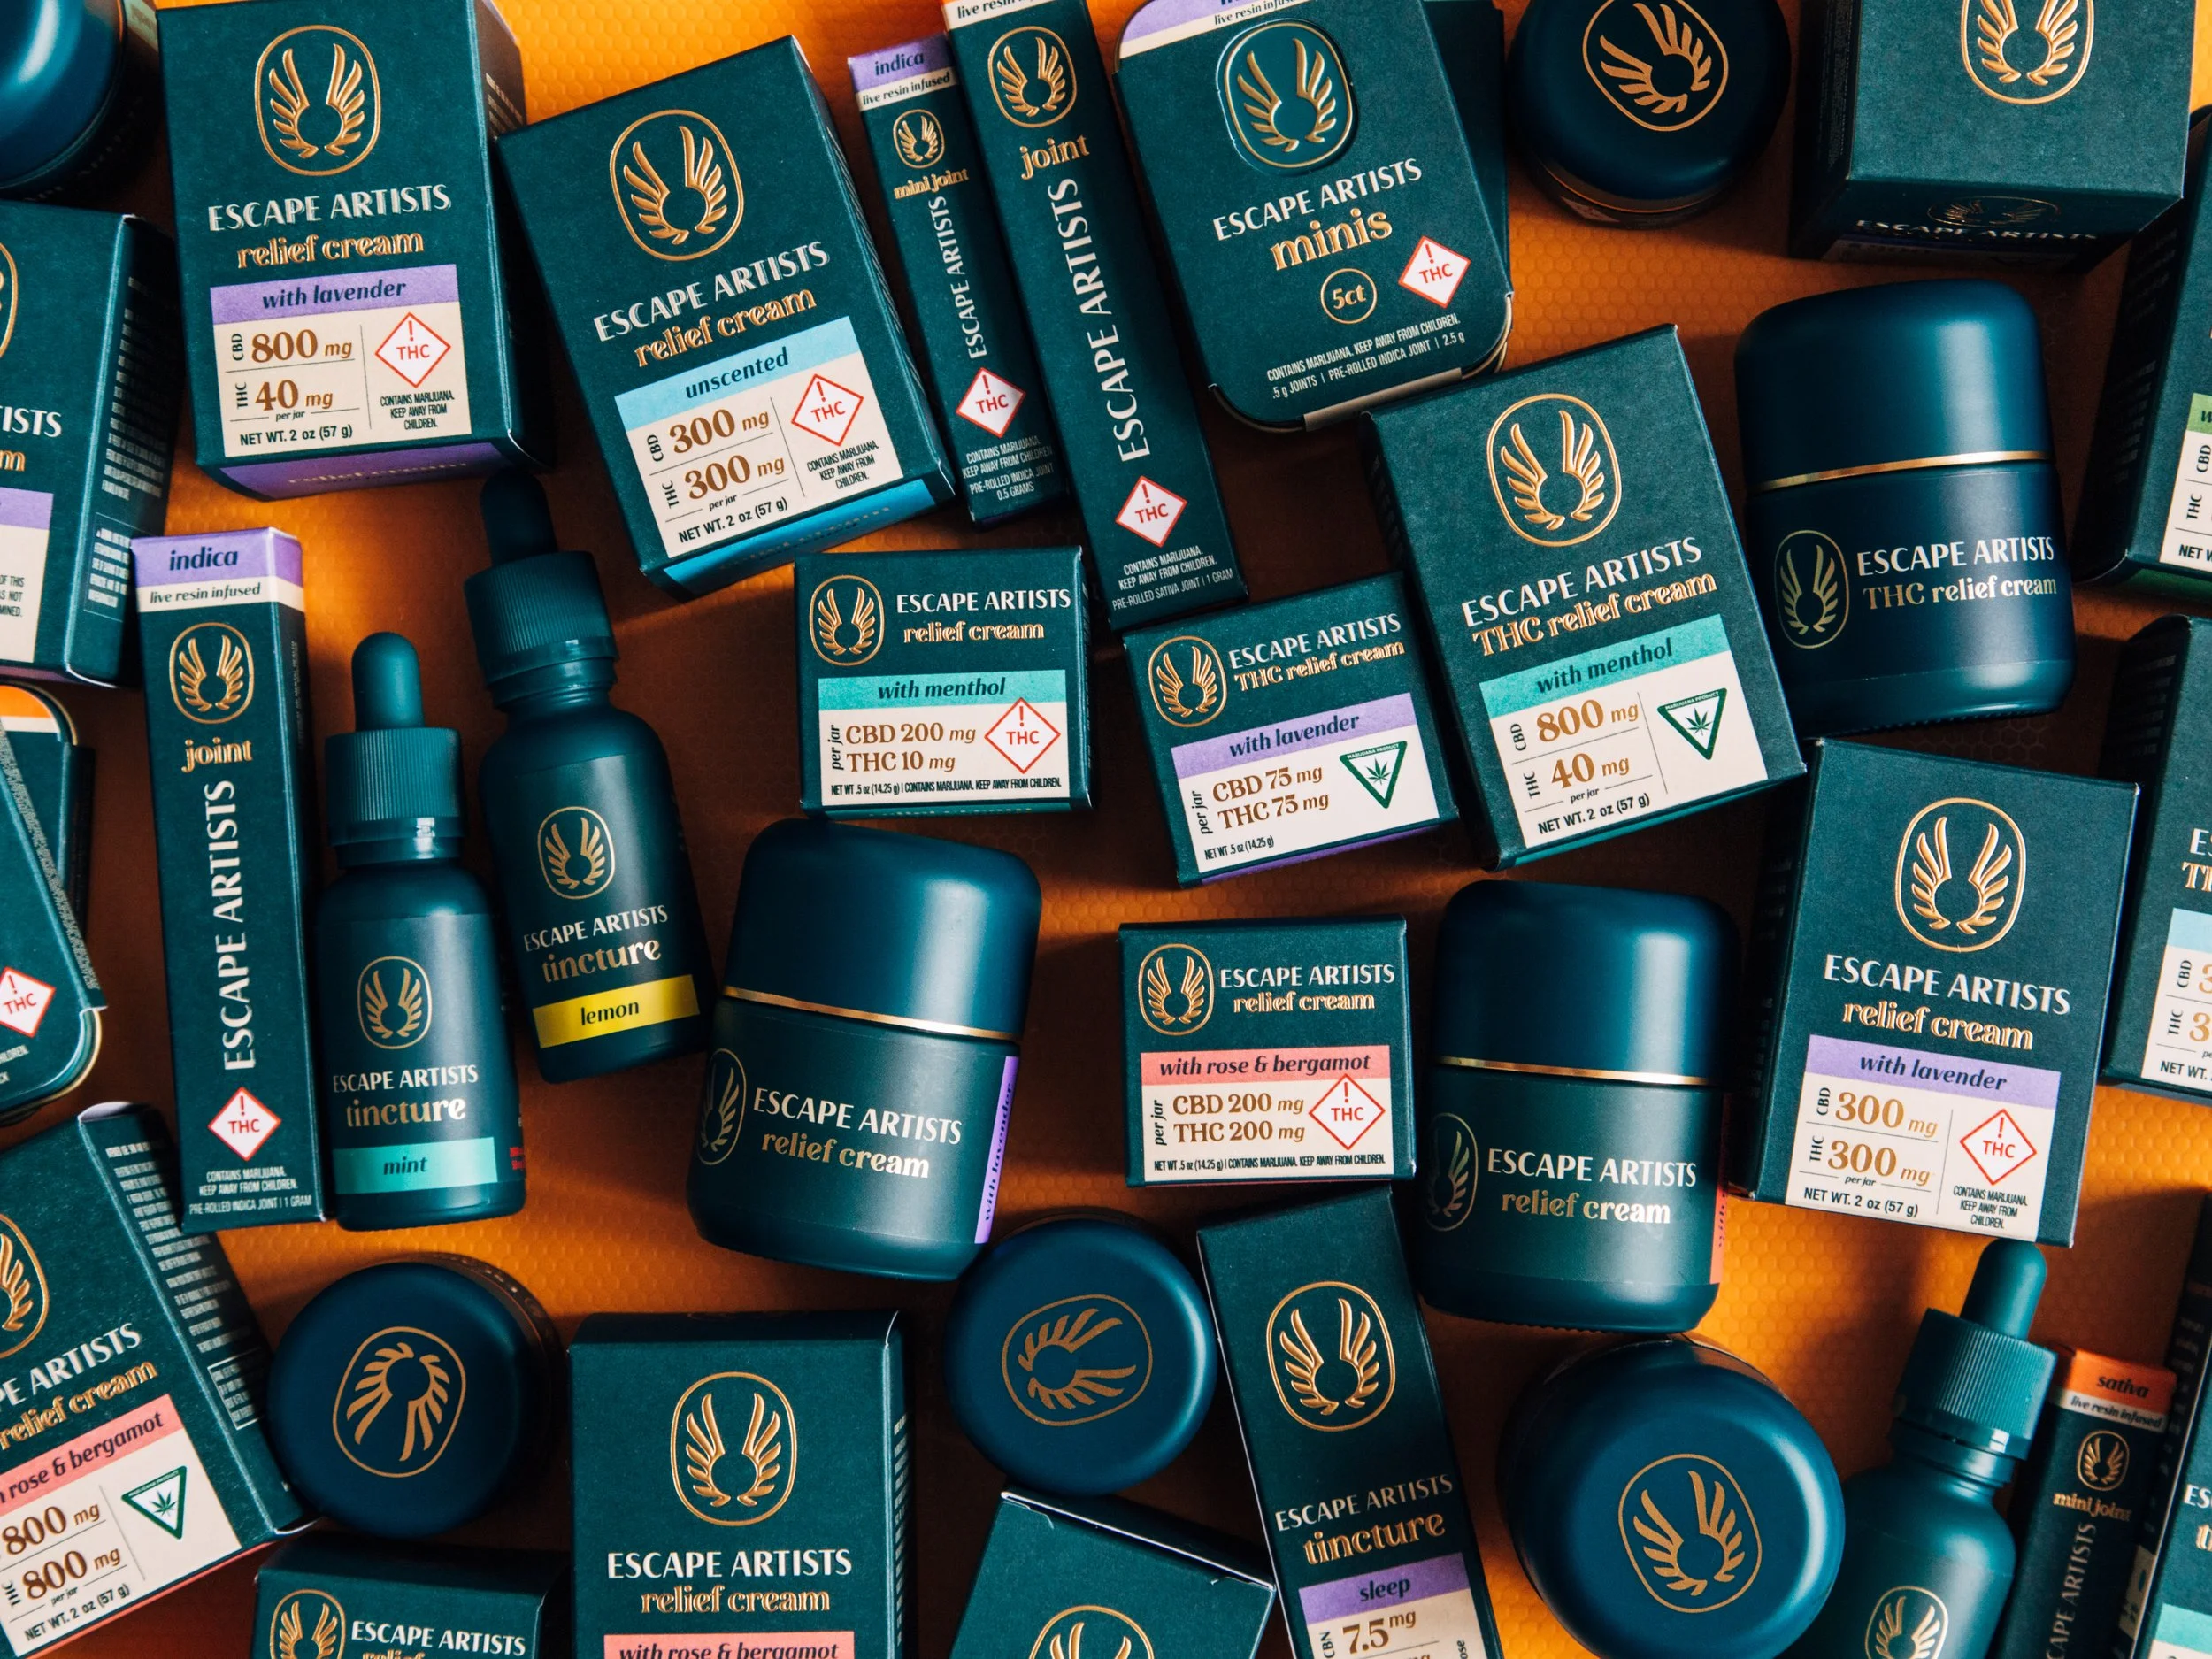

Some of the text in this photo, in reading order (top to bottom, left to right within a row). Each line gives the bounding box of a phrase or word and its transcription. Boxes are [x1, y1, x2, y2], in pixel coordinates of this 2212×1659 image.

[874, 50, 925, 76] indica
[862, 73, 950, 106] live resin infused
[1020, 134, 1090, 180] joint
[894, 168, 970, 200] mini joint
[1212, 158, 1422, 242] ESCAPE ARTISTS
[208, 184, 451, 231] ESCAPE ARTISTS
[237, 233, 424, 268] relief cream
[1270, 207, 1393, 272] minis
[928, 196, 987, 359] ESCAPE ARTISTS
[1419, 264, 1453, 284] THC
[262, 280, 406, 309] with lavender
[593, 242, 830, 342] ESCAPE ARTISTS
[1332, 284, 1366, 309] 5ct
[634, 289, 817, 367] relief cream
[1047, 178, 1151, 462] ESCAPE ARTISTS
[251, 330, 352, 363] 800 mg
[396, 344, 429, 360] THC
[1266, 313, 1460, 381] CONTAINS MARIJUANA. KEEP AWAY FROM CHILDREN.
[686, 346, 789, 399] unscented
[811, 402, 846, 424] THC
[976, 395, 1009, 414] THC
[240, 425, 353, 445] NET WT. 2 oz (57 g)
[669, 409, 770, 454] 300 mg
[1135, 503, 1169, 524] THC
[169, 546, 239, 572] indica
[1118, 555, 1217, 591] KEEP AWAY FROM CHILDREN.
[1124, 545, 1202, 575] CONTAINS MARIJUANA.
[1857, 536, 2054, 576] ESCAPE ARTISTS
[150, 582, 261, 603] live resin infused
[1461, 537, 1702, 628] ESCAPE ARTISTS
[1863, 575, 2056, 610] THC relief cream
[896, 589, 1071, 613] ESCAPE ARTISTS
[1472, 573, 1717, 657] THC relief cream
[903, 620, 1044, 643] relief cream
[1228, 613, 1402, 670] ESCAPE ARTISTS
[1235, 641, 1405, 692] THC relief cream
[1536, 637, 1673, 694] with menthol
[878, 677, 1006, 699] with menthol
[846, 723, 976, 745] CBD 200 mg
[1006, 731, 1040, 745] THC
[1229, 715, 1359, 757] with lavender
[1536, 699, 1639, 742] 800 mg
[181, 736, 253, 773] joint
[1212, 765, 1323, 803] CBD 75 mg
[204, 780, 257, 1071] ESCAPE ARTISTS
[524, 905, 668, 952] ESCAPE ARTISTS
[541, 939, 661, 984] tincture
[1220, 964, 1395, 988] ESCAPE ARTISTS
[1233, 991, 1375, 1013] relief cream
[1824, 954, 2070, 1016] ESCAPE ARTISTS
[580, 1002, 640, 1026] lemon
[1843, 1000, 2033, 1050] relief cream
[333, 1064, 479, 1094] ESCAPE ARTISTS
[1160, 1053, 1371, 1076] with rose & bergamot
[1860, 1056, 2007, 1091] with lavender
[346, 1097, 466, 1129] tincture
[753, 1087, 963, 1145] ESCAPE ARTISTS
[1172, 1093, 1304, 1116] CBD 200 mg
[1331, 1106, 1364, 1122] THC
[1835, 1091, 1939, 1139] 300 mg
[228, 1118, 261, 1135] THC
[383, 1156, 428, 1175] mint
[762, 1132, 929, 1179] relief cream
[1982, 1140, 2016, 1159] THC
[1487, 1148, 1697, 1187] ESCAPE ARTISTS
[1502, 1189, 1671, 1224] relief cream
[30, 1323, 142, 1395] ARTISTS
[2096, 1374, 2150, 1400] sativa
[0, 1395, 68, 1450] relief
[68, 1360, 158, 1415] cream
[1275, 1473, 1453, 1532] ESCAPE ARTISTS
[1302, 1513, 1446, 1565] tincture
[607, 1548, 852, 1578] ESCAPE ARTISTS
[641, 1585, 830, 1614] relief cream
[1359, 1578, 1410, 1602] sleep
[351, 1620, 526, 1656] ESCAPE ARTISTS
[1342, 1609, 1417, 1655] 7.5 mg
